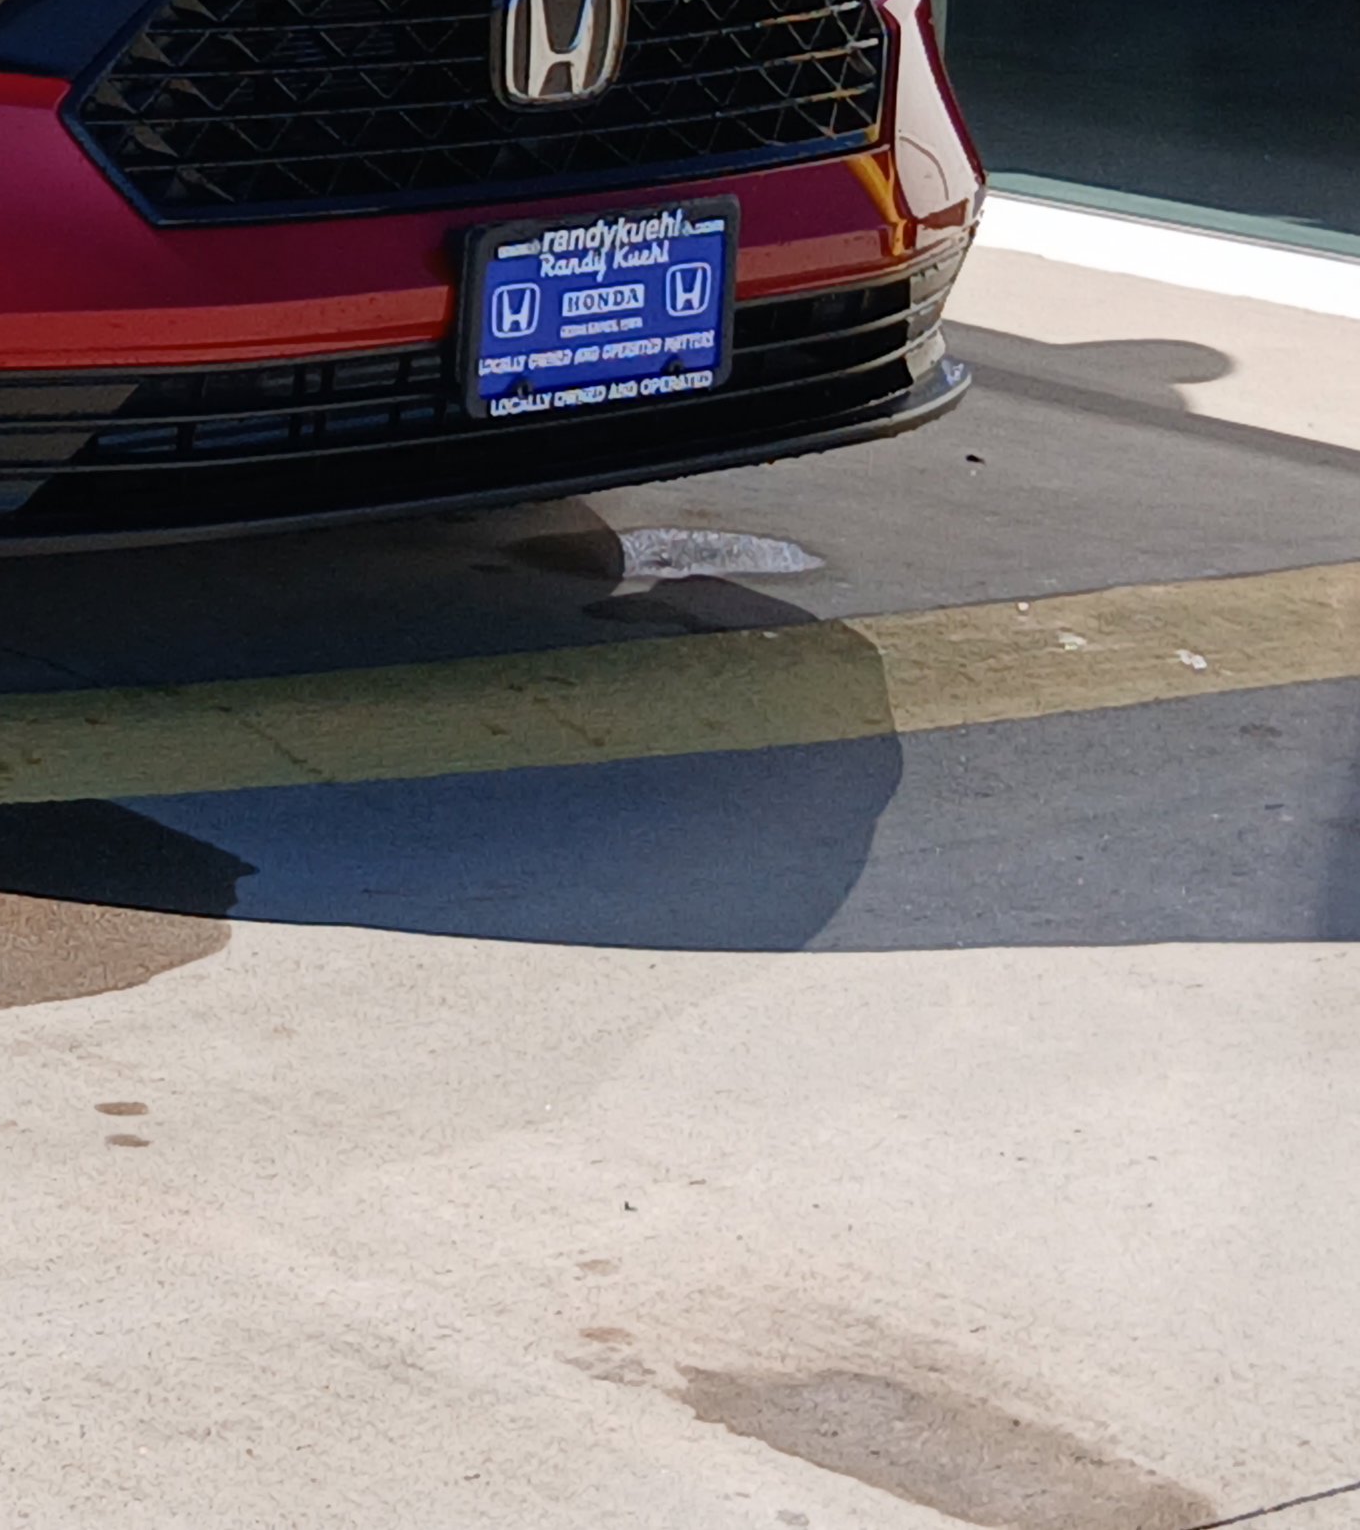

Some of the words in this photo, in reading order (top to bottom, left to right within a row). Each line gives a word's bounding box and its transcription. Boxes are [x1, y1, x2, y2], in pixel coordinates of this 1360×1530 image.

[540, 249, 606, 282] Randy
[613, 239, 670, 269] Kuehl
[567, 288, 640, 313] HONDA
[491, 392, 552, 417] LOCALLY
[640, 370, 713, 396] OPERATED
